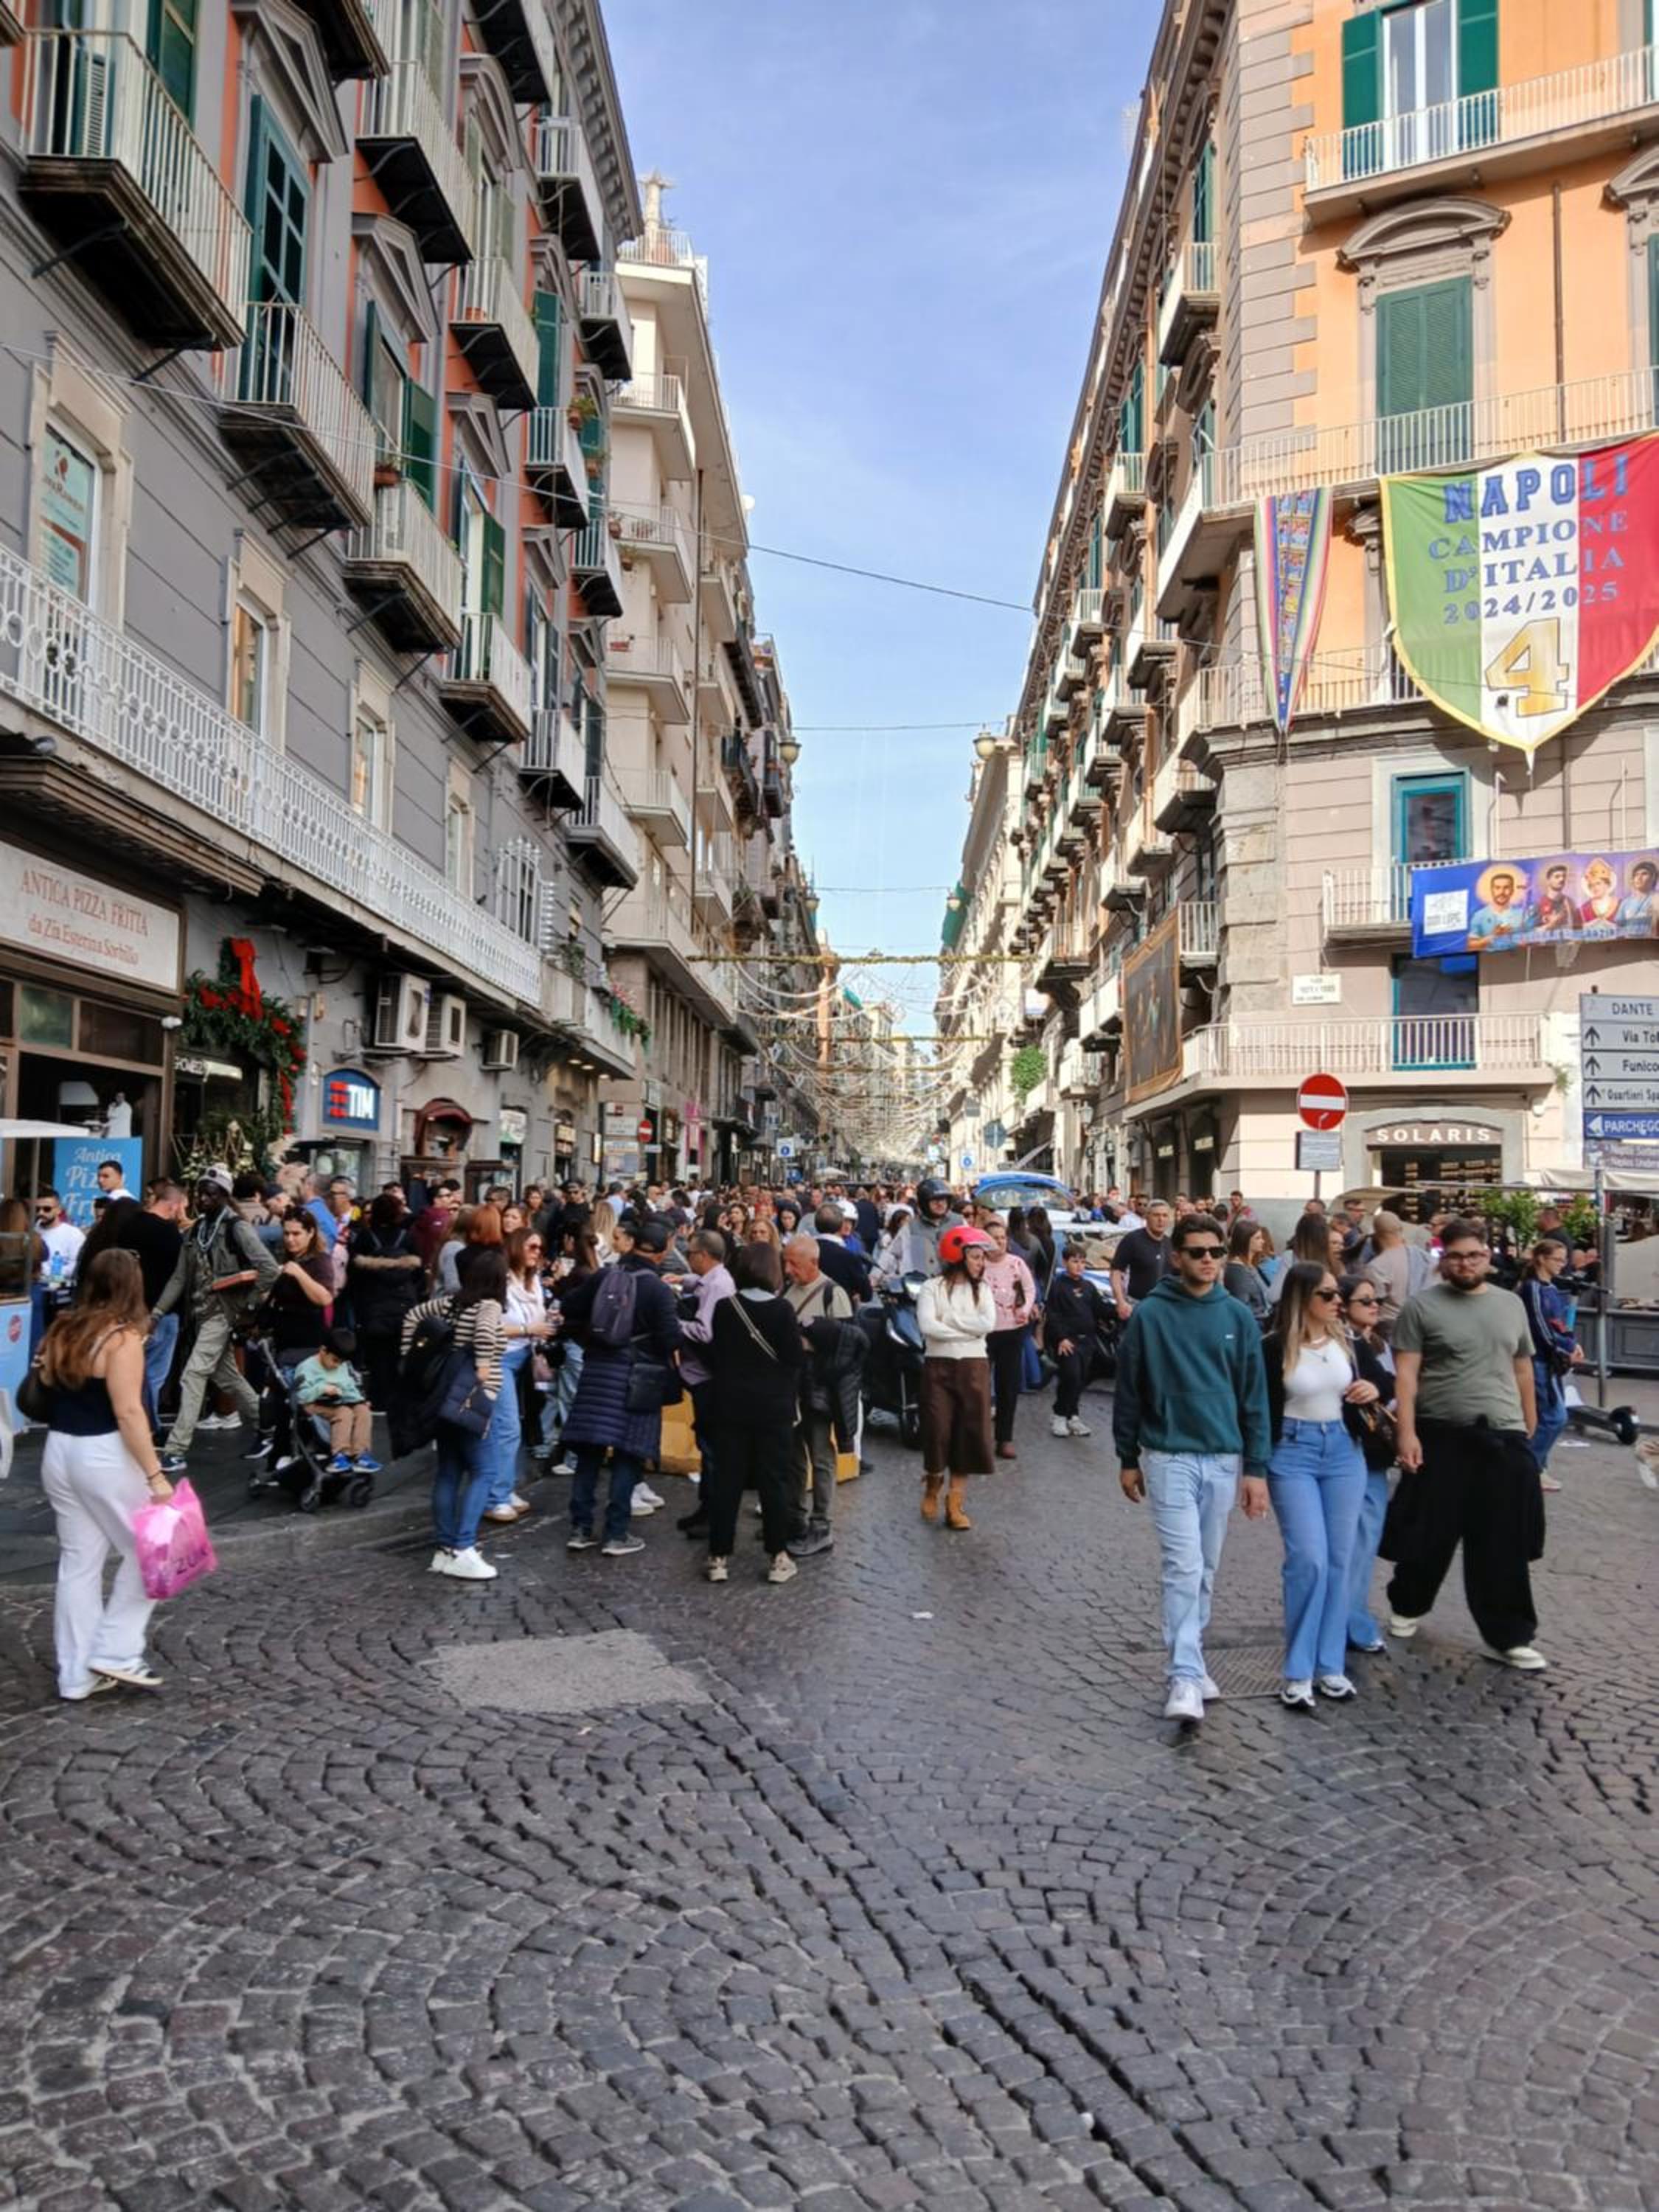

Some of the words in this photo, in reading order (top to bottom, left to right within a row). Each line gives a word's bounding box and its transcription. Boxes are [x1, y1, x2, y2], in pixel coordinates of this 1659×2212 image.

[1443, 453, 1630, 524] NAPOLI
[1428, 511, 1629, 561] CAMPIONE
[1444, 546, 1624, 594] D'ITALIA
[1443, 581, 1619, 625] 2024/2025
[1485, 616, 1570, 718] 4
[21, 870, 71, 909] ANTICA
[72, 887, 107, 922] PIZZA
[111, 902, 149, 938] FRITTA
[1612, 1003, 1653, 1015] DANTE
[1623, 1031, 1639, 1043] Via
[347, 1083, 375, 1120] TIM
[74, 1147, 122, 1163] Antica
[1377, 1128, 1491, 1142] SOLARIS
